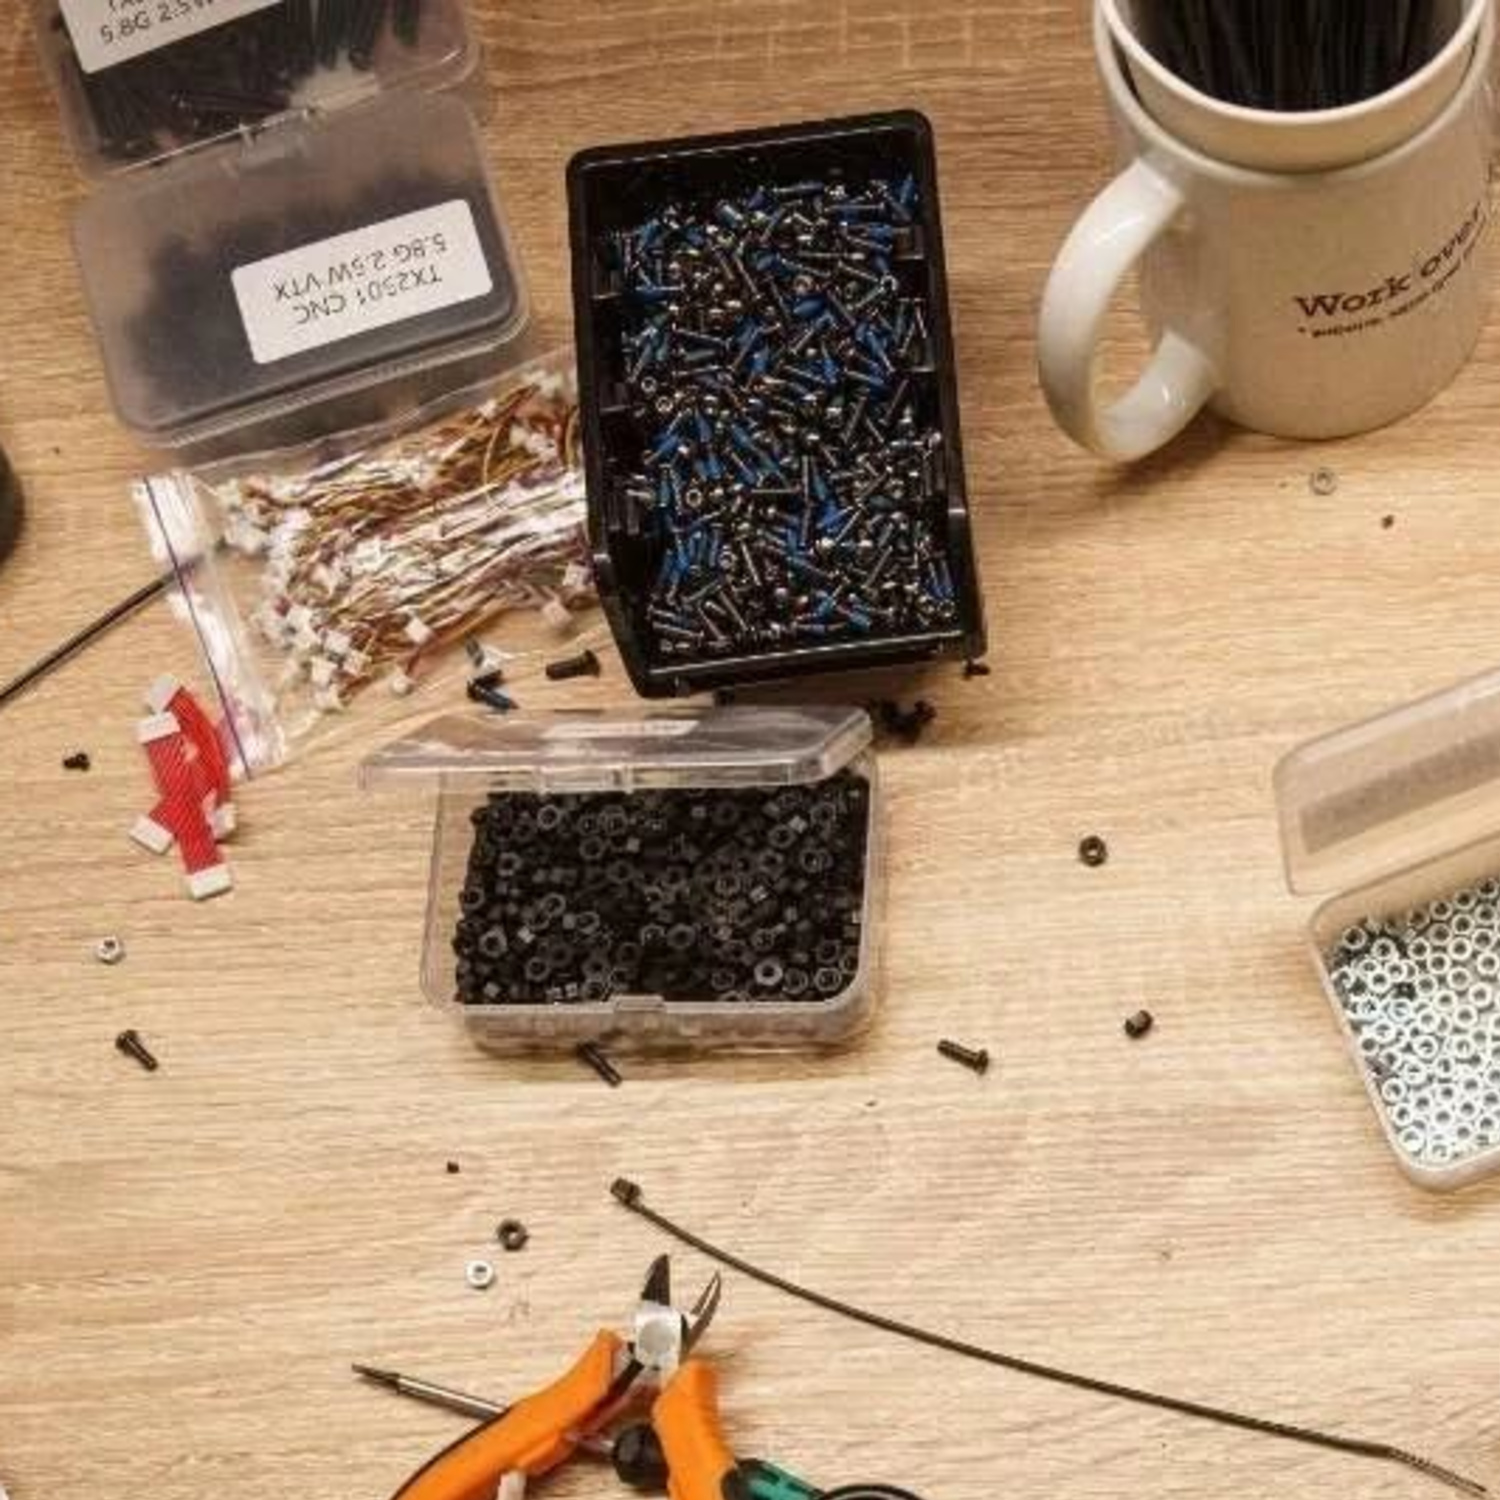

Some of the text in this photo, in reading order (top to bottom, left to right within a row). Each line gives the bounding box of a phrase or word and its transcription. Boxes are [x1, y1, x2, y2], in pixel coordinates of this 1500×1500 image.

[273, 232, 448, 302] 5.8G 2.5W VTX
[292, 293, 348, 325] CNC
[1293, 272, 1417, 318] Work
